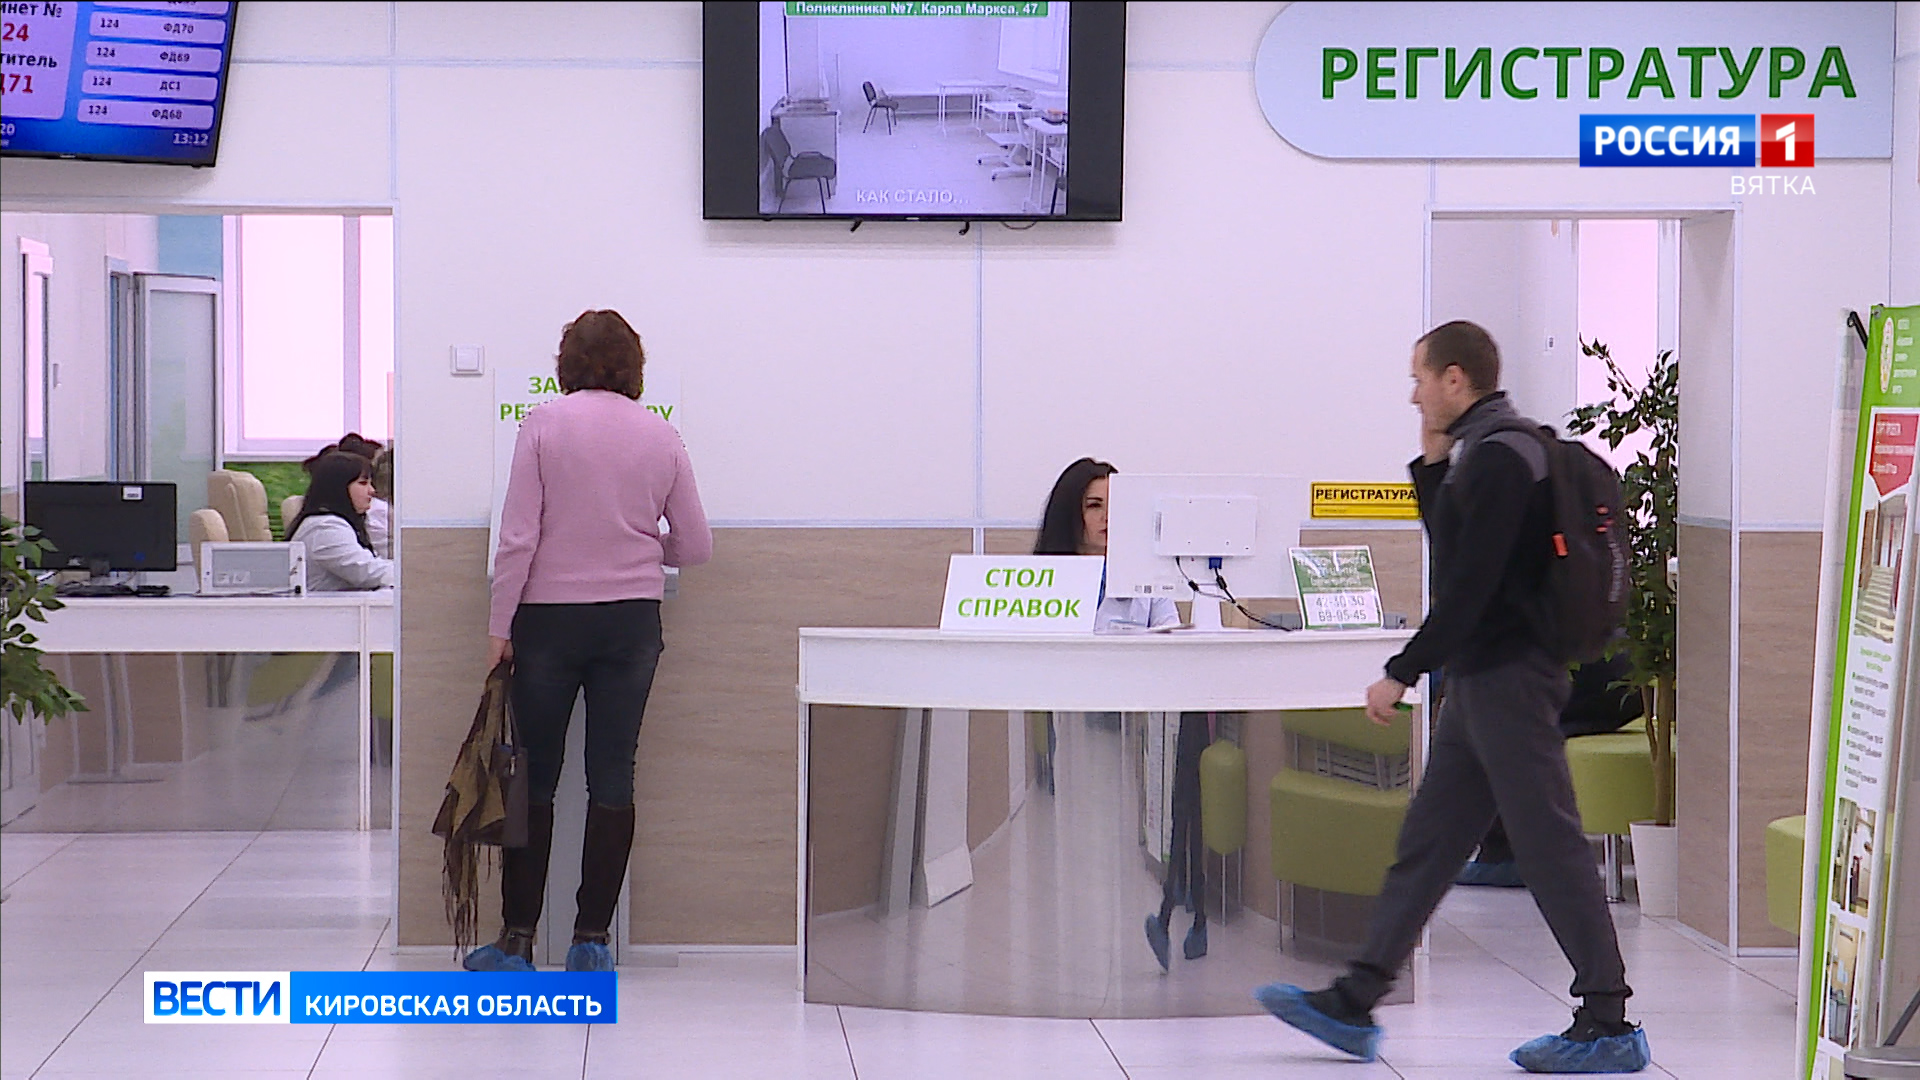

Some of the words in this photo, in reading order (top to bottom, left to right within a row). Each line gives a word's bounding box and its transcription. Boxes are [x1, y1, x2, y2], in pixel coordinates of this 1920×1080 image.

[796, 1, 887, 14] Поликлиника
[921, 3, 962, 17] Карла
[965, 3, 1019, 17] Маркса,
[1022, 3, 1038, 14] 47
[2, 22, 29, 42] 24
[100, 19, 119, 28] 124
[163, 23, 194, 34] ФД70
[96, 47, 116, 57] 124
[159, 51, 190, 62] ФД69
[1321, 46, 1857, 100] РЕГИСТРАТУРА
[92, 76, 112, 86] 124
[88, 105, 108, 115] 124
[151, 109, 182, 120] ФД68
[172, 133, 209, 145] 13:12
[856, 189, 889, 203] КАК
[1315, 489, 1417, 500] РЕГИСТРАТУРА
[985, 568, 1055, 588] СТОЛ
[957, 598, 1081, 618] СПРАВОК
